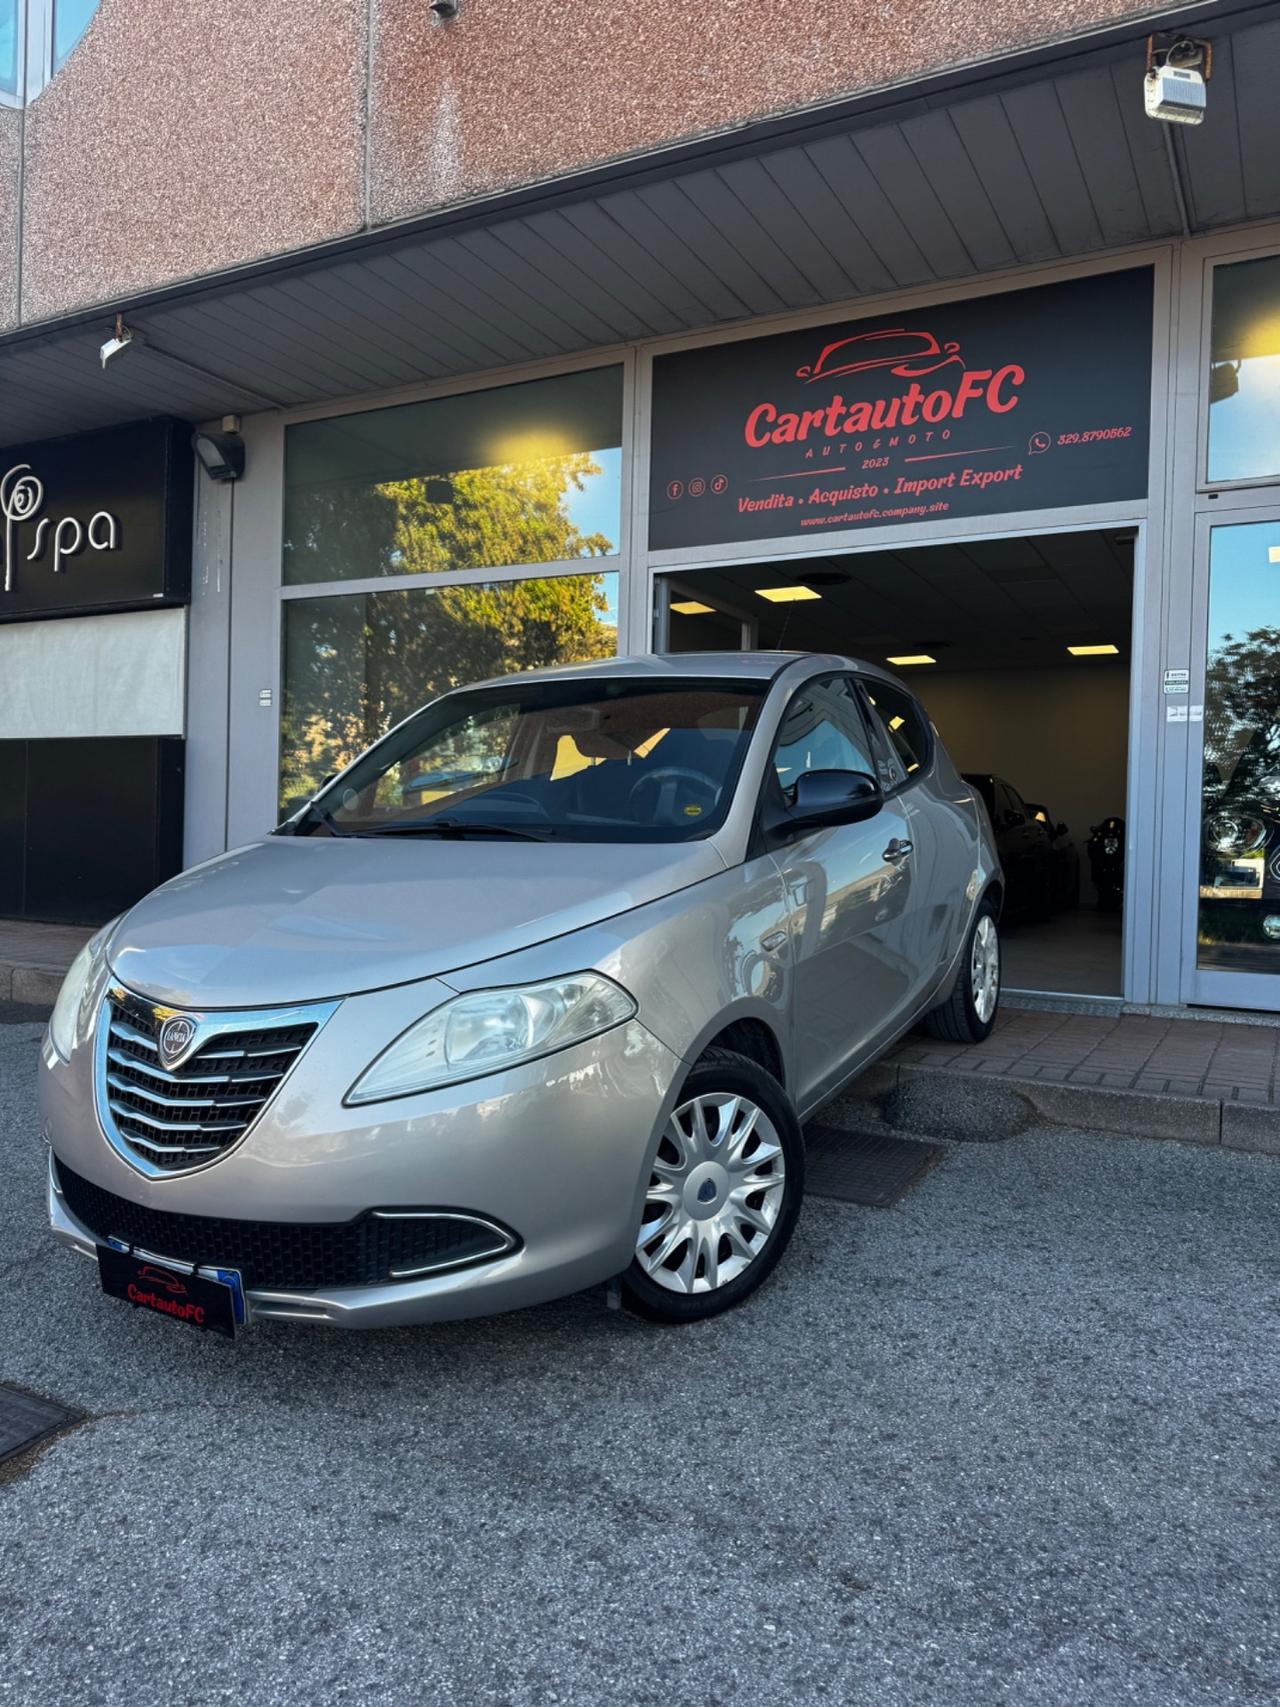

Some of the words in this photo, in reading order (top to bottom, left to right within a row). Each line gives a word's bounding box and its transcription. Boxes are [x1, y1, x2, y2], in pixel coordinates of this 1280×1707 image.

[743, 364, 1025, 448] CartautoFC
[862, 457, 889, 469] 2023
[737, 494, 795, 513] Vendita
[808, 483, 878, 506] Acquisto
[894, 472, 956, 496] Import
[959, 464, 1023, 488] Export
[800, 502, 949, 526] www.cartautofc.company.site
[128, 1283, 205, 1324] CartautoFC
